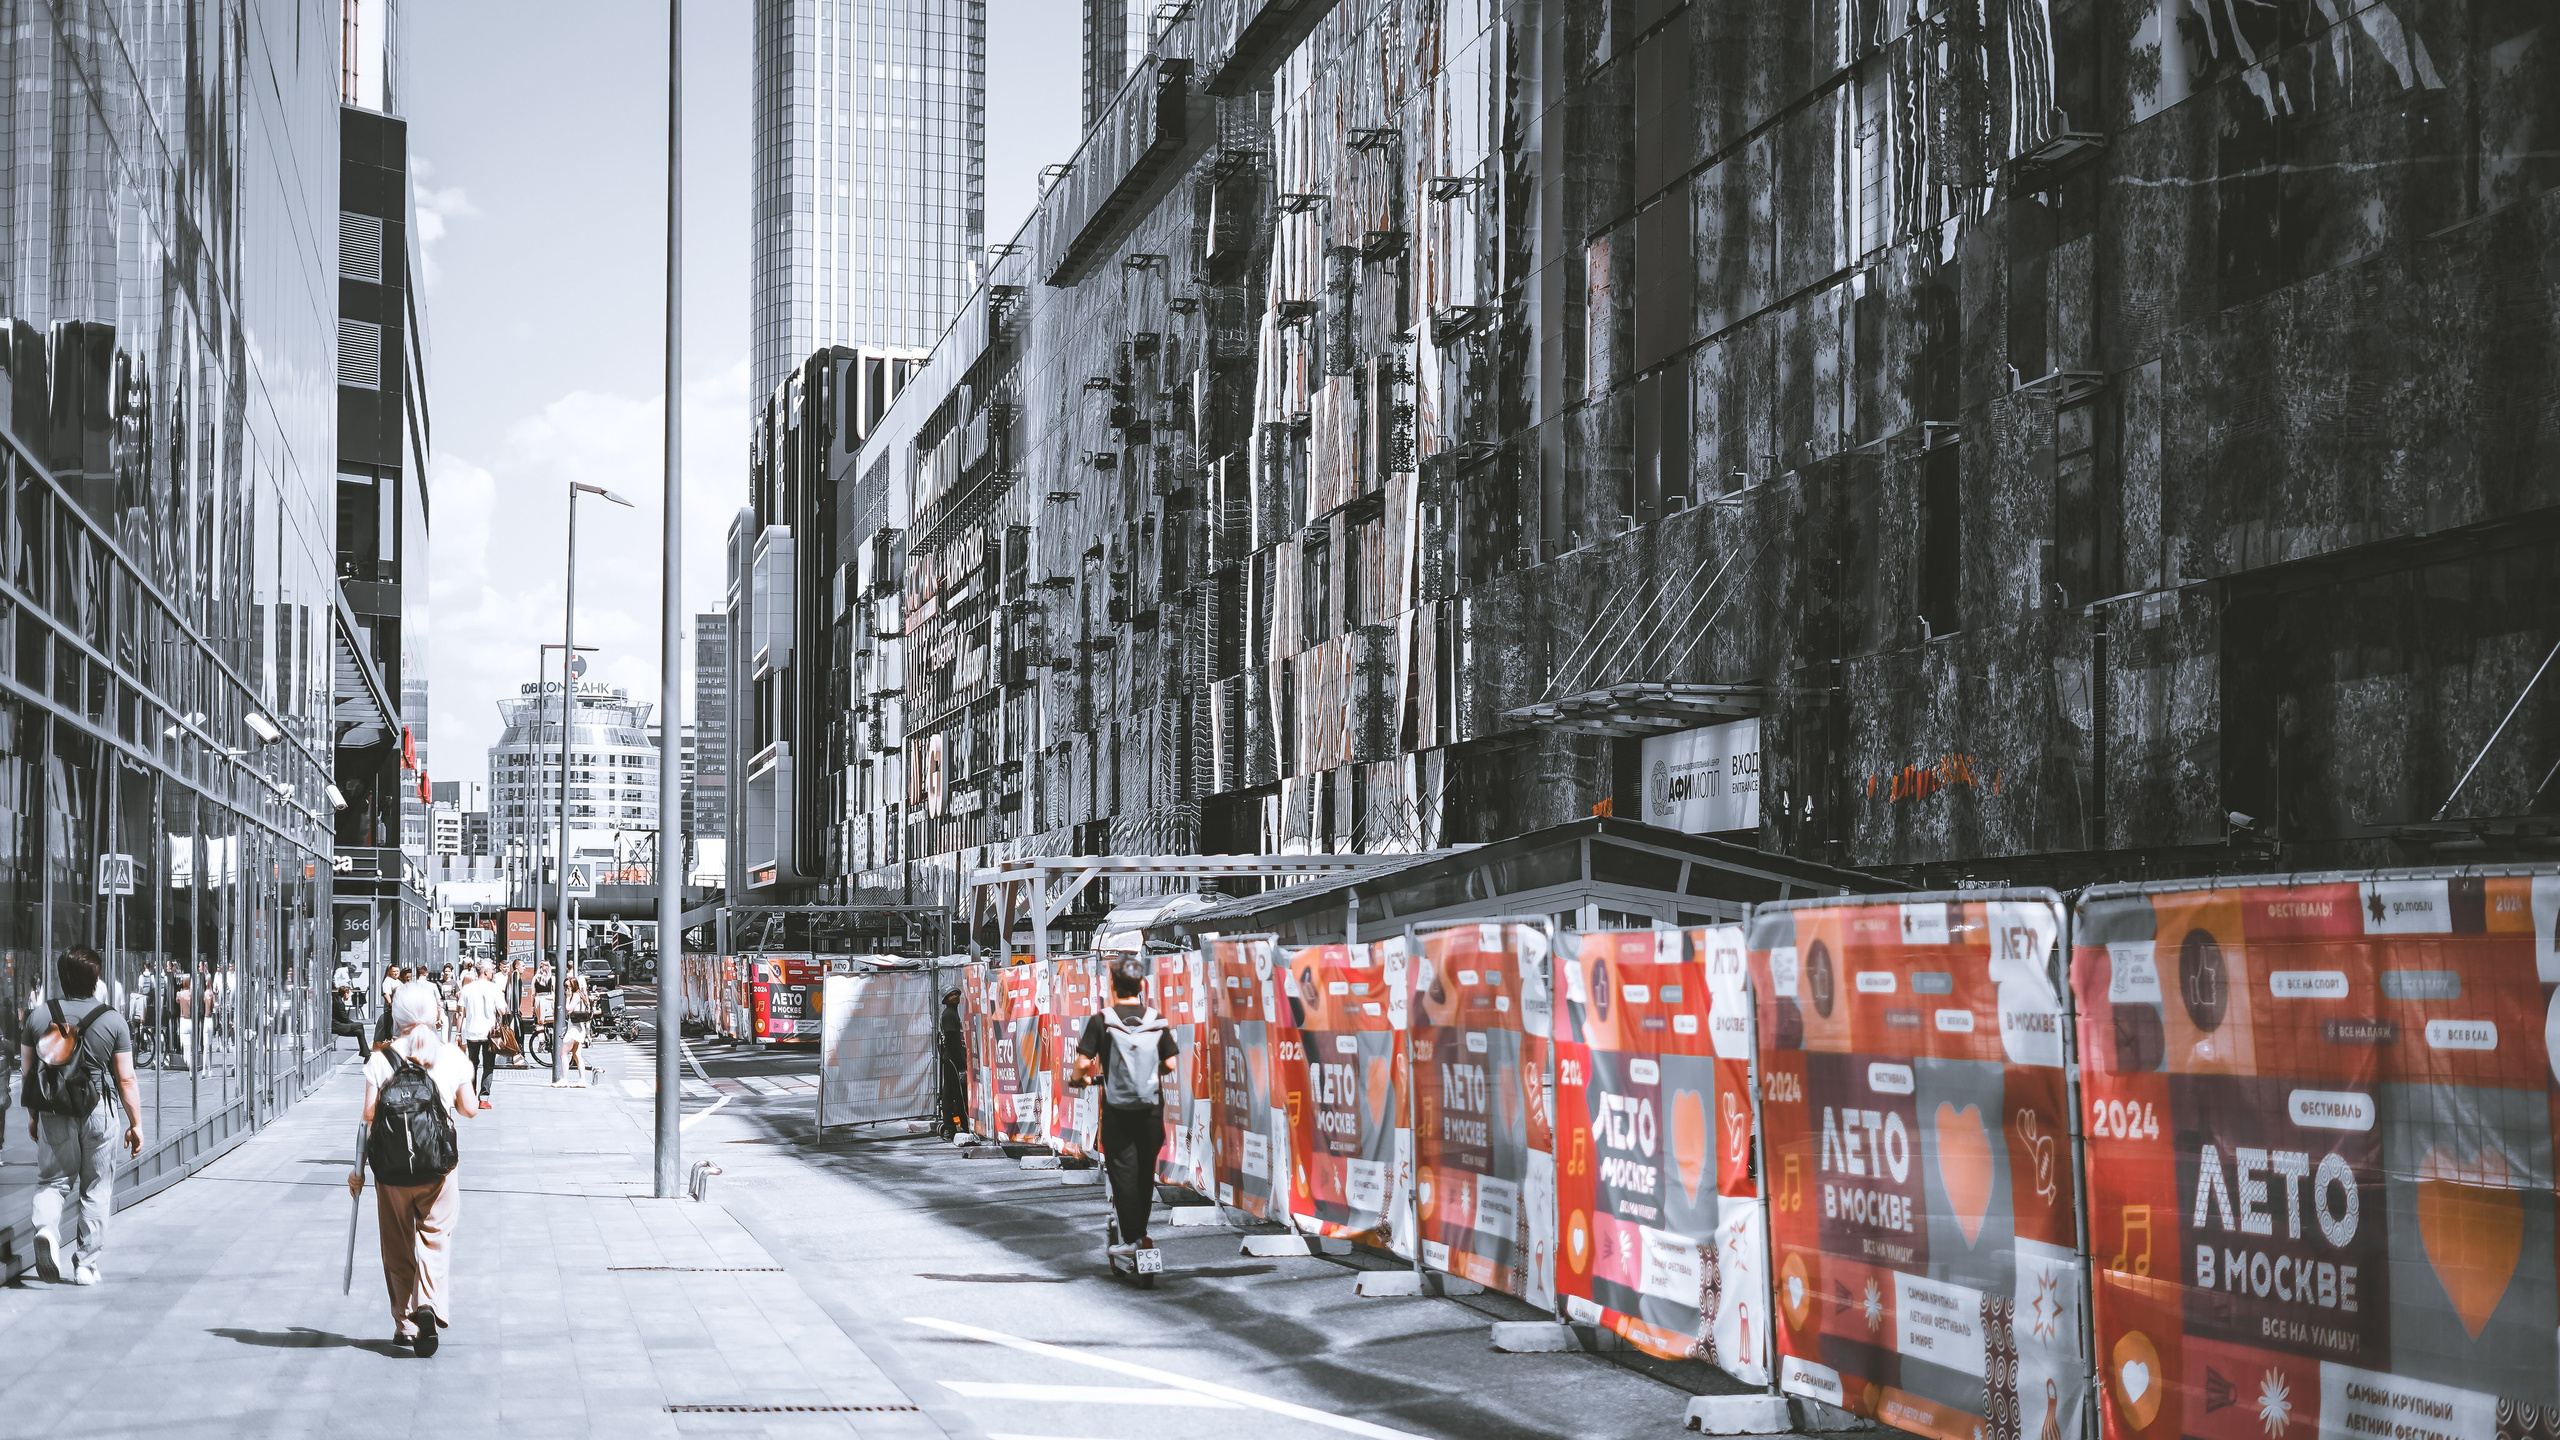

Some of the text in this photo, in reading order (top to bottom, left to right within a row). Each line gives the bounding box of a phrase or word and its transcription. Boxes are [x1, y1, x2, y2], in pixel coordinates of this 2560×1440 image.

[1732, 752, 1759, 777] ВХОД
[1668, 770, 1720, 803] АФИМОЛЛ
[1732, 780, 1759, 794] ENTRANCE
[2268, 902, 2333, 918] ФЕСТИВАЛЬ!
[2393, 900, 2433, 915] go.mos.ru
[2496, 896, 2524, 912] 2024
[2287, 979, 2340, 989] ВСЕ НА СПОРТ
[772, 992, 802, 1006] ЛЕТО
[777, 1006, 802, 1014] МОСКВЕ
[2006, 1012, 2056, 1033] В МОСКВЕ
[2339, 1027, 2354, 1038] ВСЕ
[2355, 1027, 2366, 1038] НА
[2448, 1029, 2488, 1042] ВСЕ В САД
[1310, 1062, 1356, 1107] ЛЕТО
[1442, 1063, 1486, 1114] ЛЕТО
[1766, 1072, 1801, 1102] 2024
[2093, 1099, 2159, 1140] 2024
[2300, 1100, 2362, 1120] ФЕСТИВАЛЬ
[1444, 1117, 1487, 1147] В МОСКВЕ
[1822, 1106, 1909, 1183] ЛЕТО
[2193, 1143, 2360, 1248] ЛЕТО
[1824, 1184, 1913, 1233] В МОСКВЕ
[1863, 1239, 1875, 1254] ВСЕ
[1139, 1262, 1161, 1271] 228
[2196, 1244, 2359, 1313] В МОСКВЕ
[1909, 1309, 1972, 1336] ЛЕТНИЙ ФЕСТИВАЛЬ
[2262, 1317, 2360, 1354] ВСЕ НА УЛИЦУ!
[2346, 1382, 2453, 1421] САМЫЙ КРУПНЫЙ
[2346, 1412, 2392, 1437] ЛЕТНИЙ
